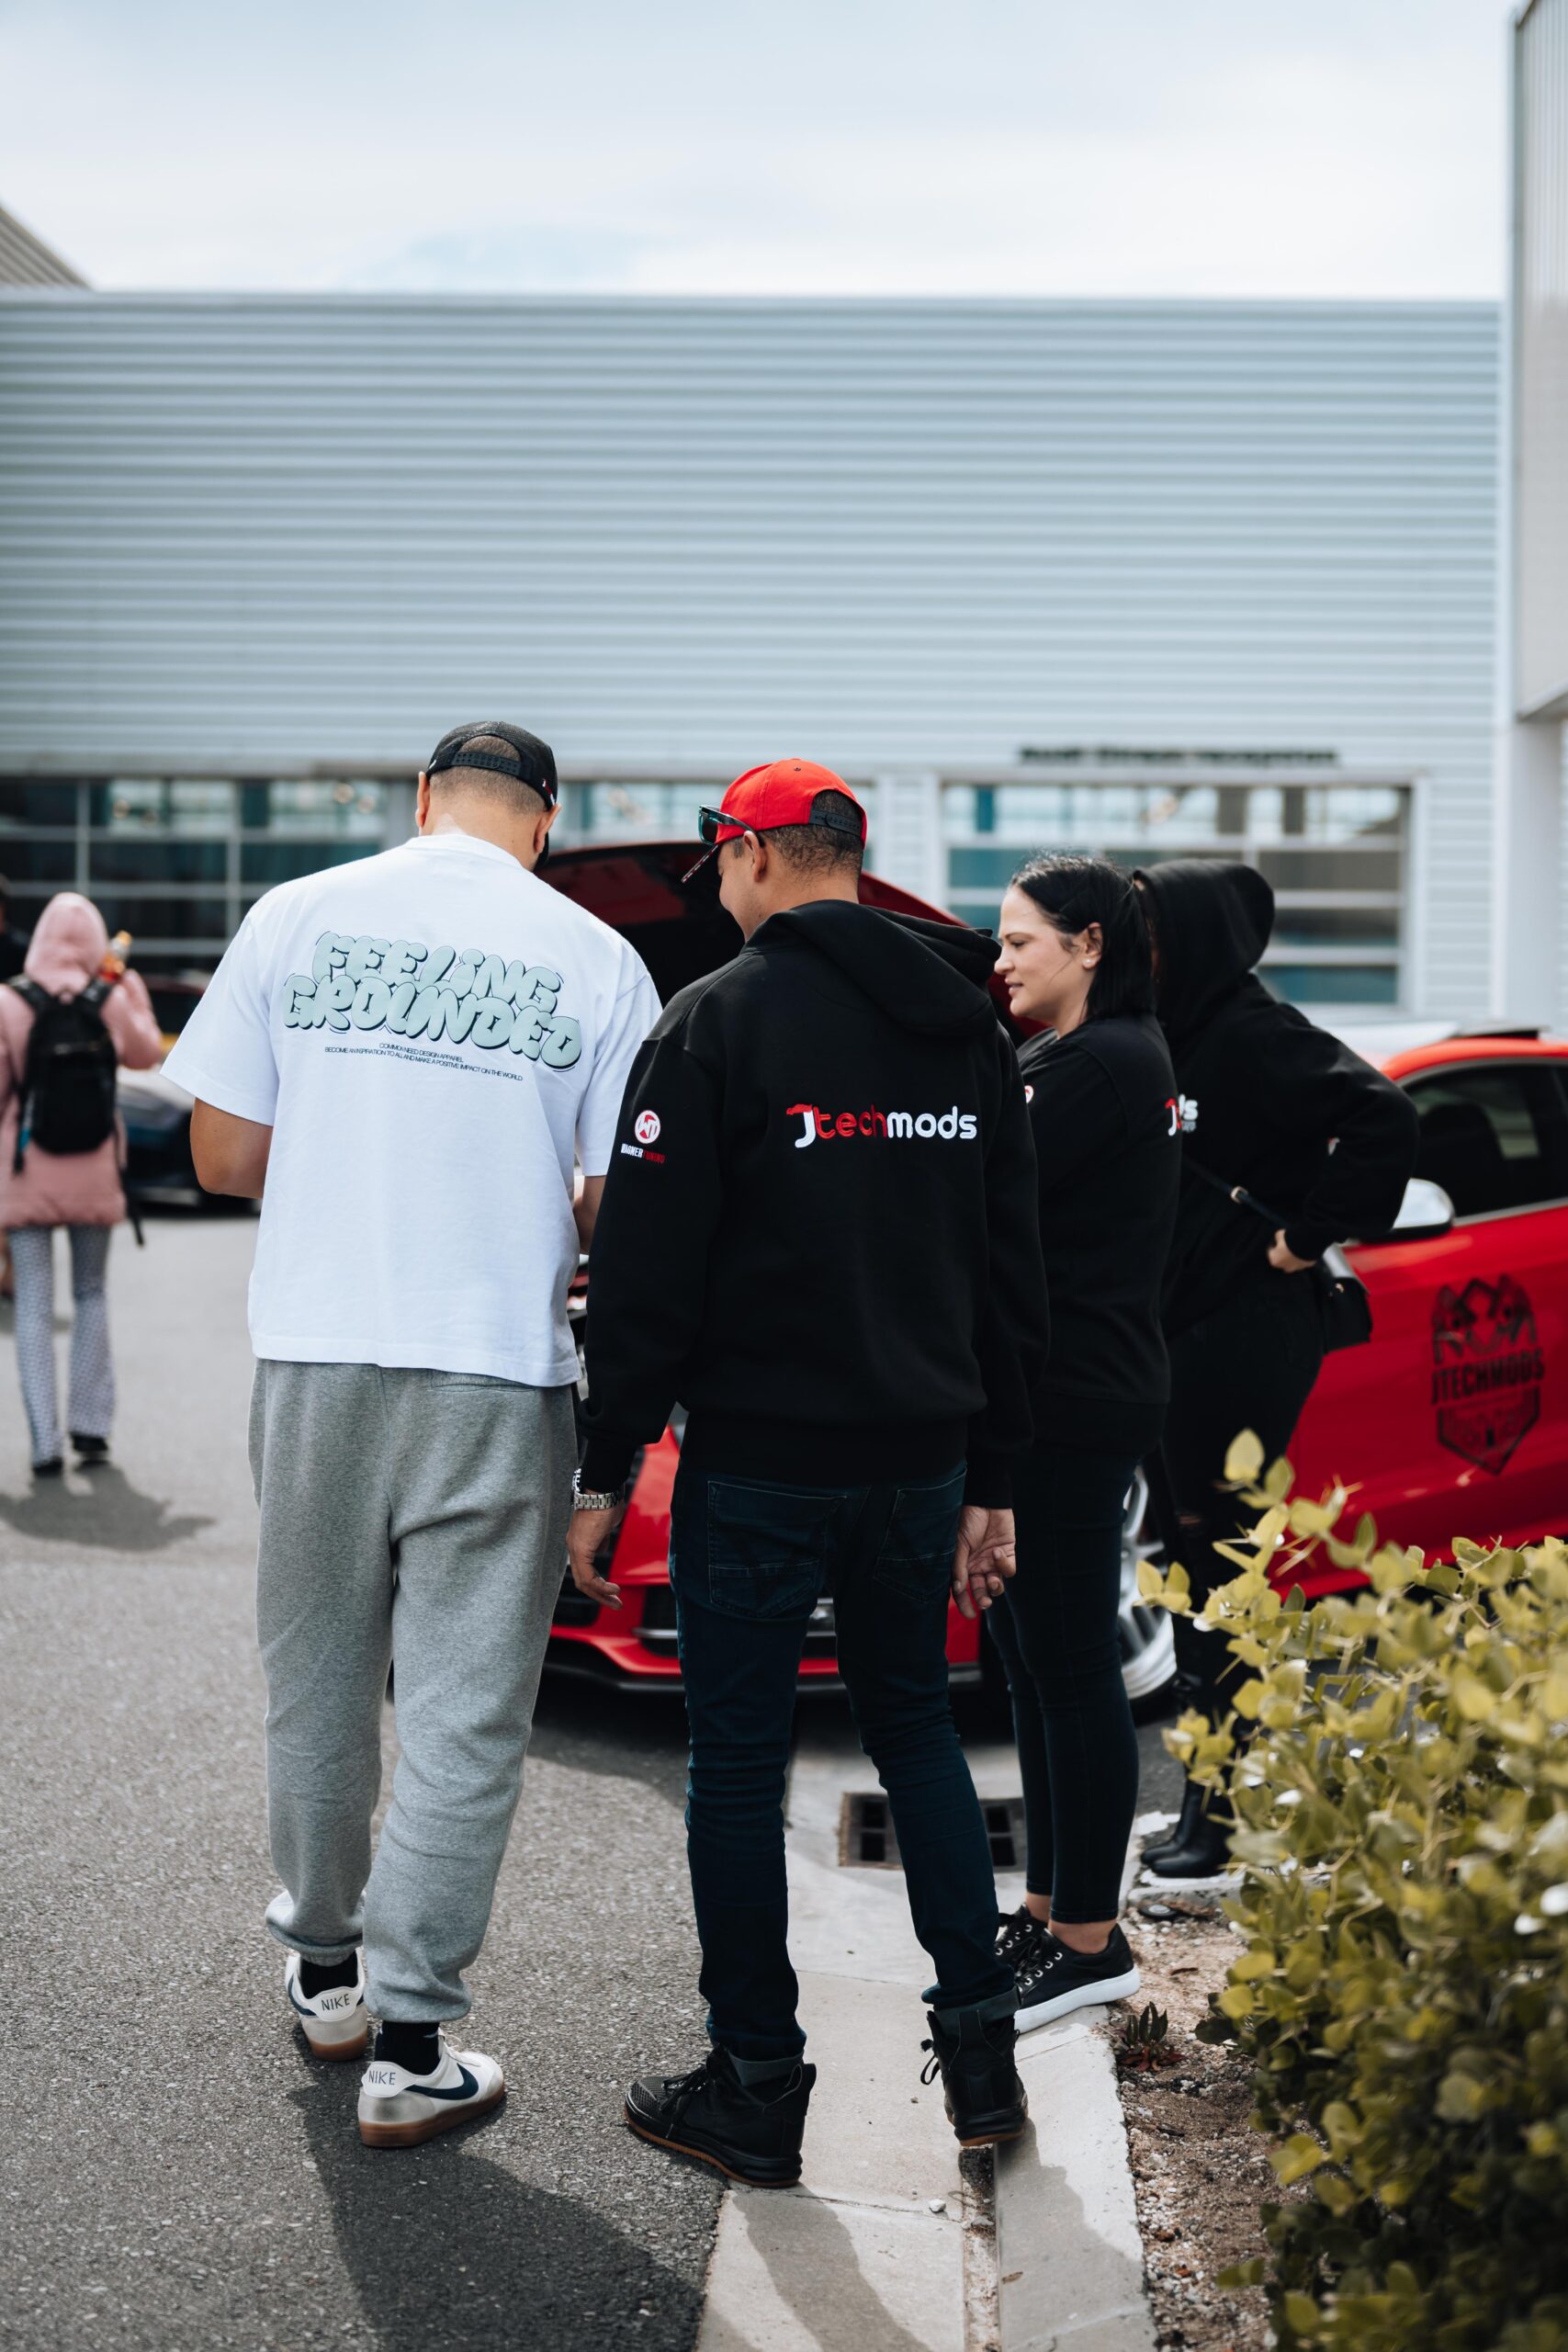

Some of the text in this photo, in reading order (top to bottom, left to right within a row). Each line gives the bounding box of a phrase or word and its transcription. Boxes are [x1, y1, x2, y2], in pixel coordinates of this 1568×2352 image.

[283, 975, 582, 1069] GROUNDED
[420, 1049, 439, 1058] DESIGN
[440, 1054, 463, 1063] APPAREL
[415, 1056, 431, 1064] MAKE
[436, 1059, 459, 1069] POSITIVE
[460, 1064, 480, 1072] IMPACT
[502, 1072, 524, 1081] WORLD
[785, 1103, 977, 1148] Jtechmods
[321, 1993, 351, 2011] NIKE
[368, 2070, 396, 2086] NIKE
